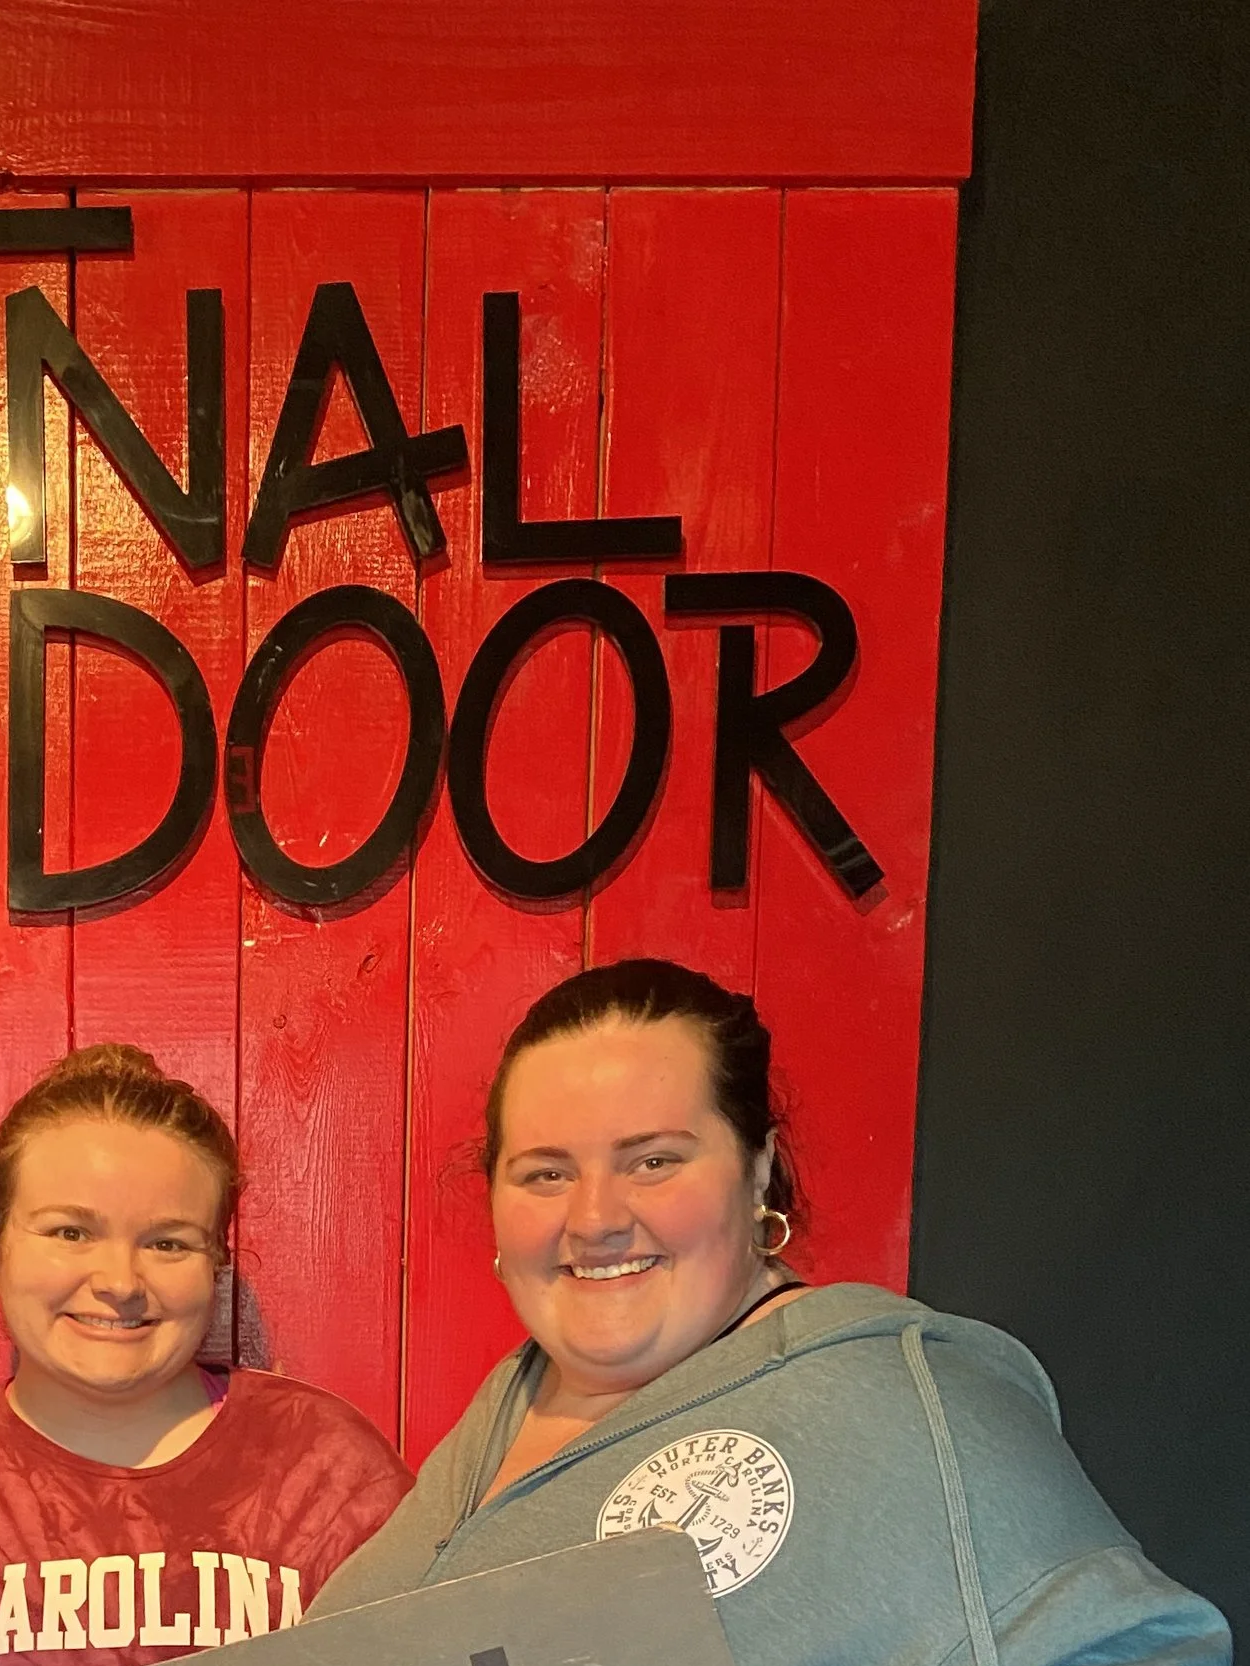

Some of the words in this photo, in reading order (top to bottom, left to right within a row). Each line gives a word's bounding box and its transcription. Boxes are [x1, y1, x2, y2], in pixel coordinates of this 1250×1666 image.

[8, 570, 886, 907] DOOR
[647, 1436, 739, 1474] OUTER
[744, 1447, 785, 1534] BANKS
[650, 1484, 678, 1504] EST.
[709, 1514, 741, 1539] 1729
[657, 1453, 716, 1479] NORTH
[724, 1456, 764, 1528] CAROLINA
